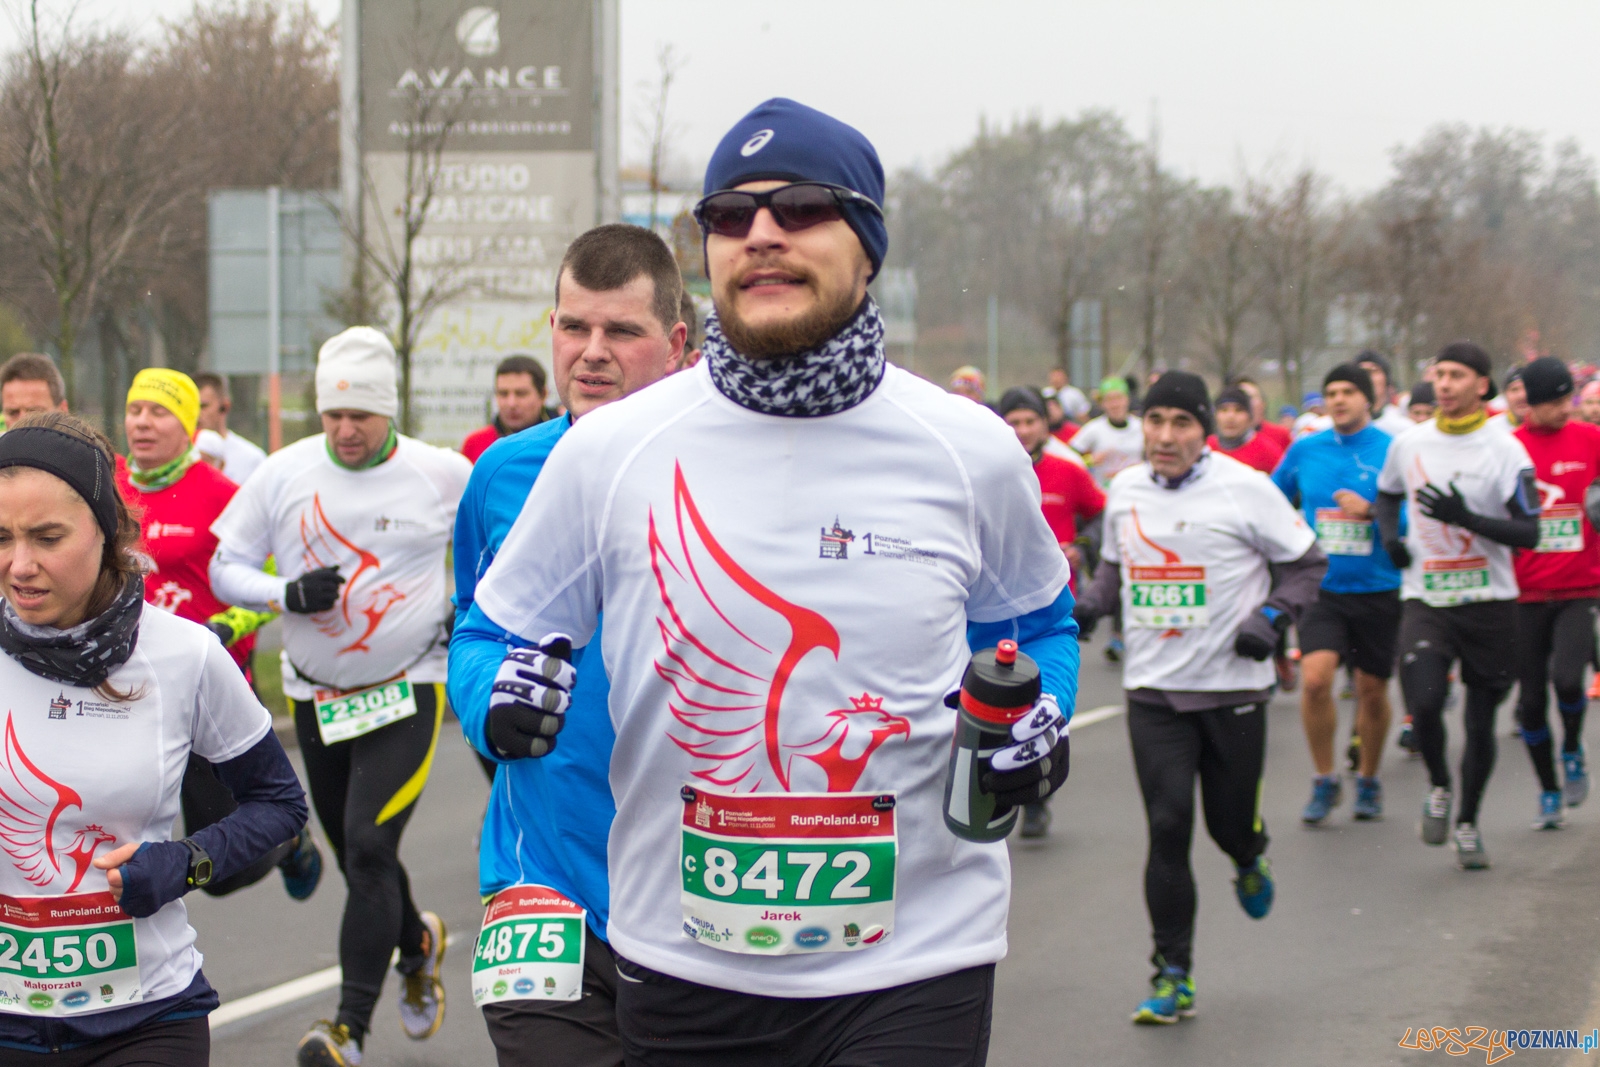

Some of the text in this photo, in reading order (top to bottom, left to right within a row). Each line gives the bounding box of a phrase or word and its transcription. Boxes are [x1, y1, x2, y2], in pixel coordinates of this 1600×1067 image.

[396, 65, 562, 90] AVANCE
[1136, 585, 1194, 606] 7661
[330, 684, 402, 721] 2308
[717, 809, 727, 827] 1
[790, 814, 880, 827] RunPoland.org
[684, 847, 871, 900] C 8472
[50, 905, 120, 918] RunPoland.org
[760, 910, 802, 921] Jarek
[0, 932, 118, 974] 2450
[482, 923, 565, 964] 4875
[498, 967, 522, 976] Robert
